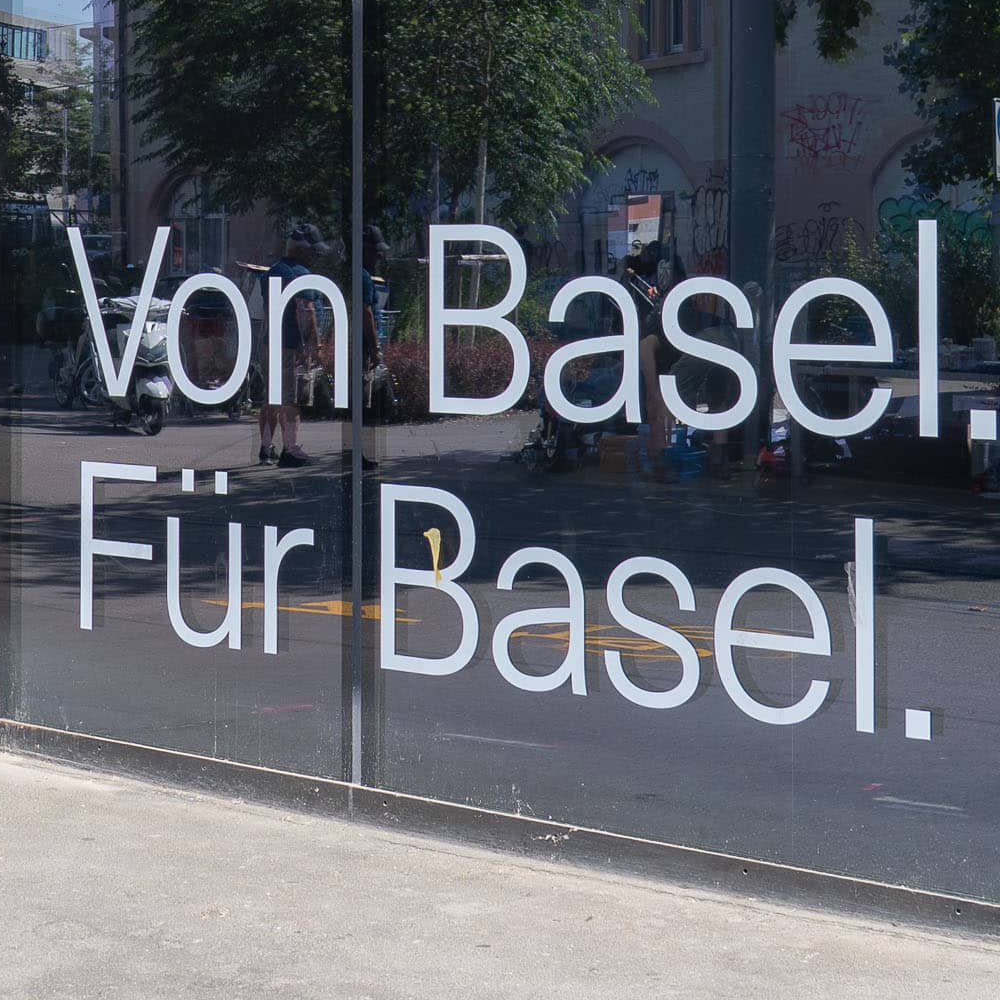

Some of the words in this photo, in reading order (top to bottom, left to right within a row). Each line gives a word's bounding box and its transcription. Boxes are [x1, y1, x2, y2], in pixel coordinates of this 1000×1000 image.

[66, 225, 351, 410] Von
[428, 218, 999, 442] Basel.
[79, 460, 316, 655] Für
[380, 483, 933, 742] Basel.
